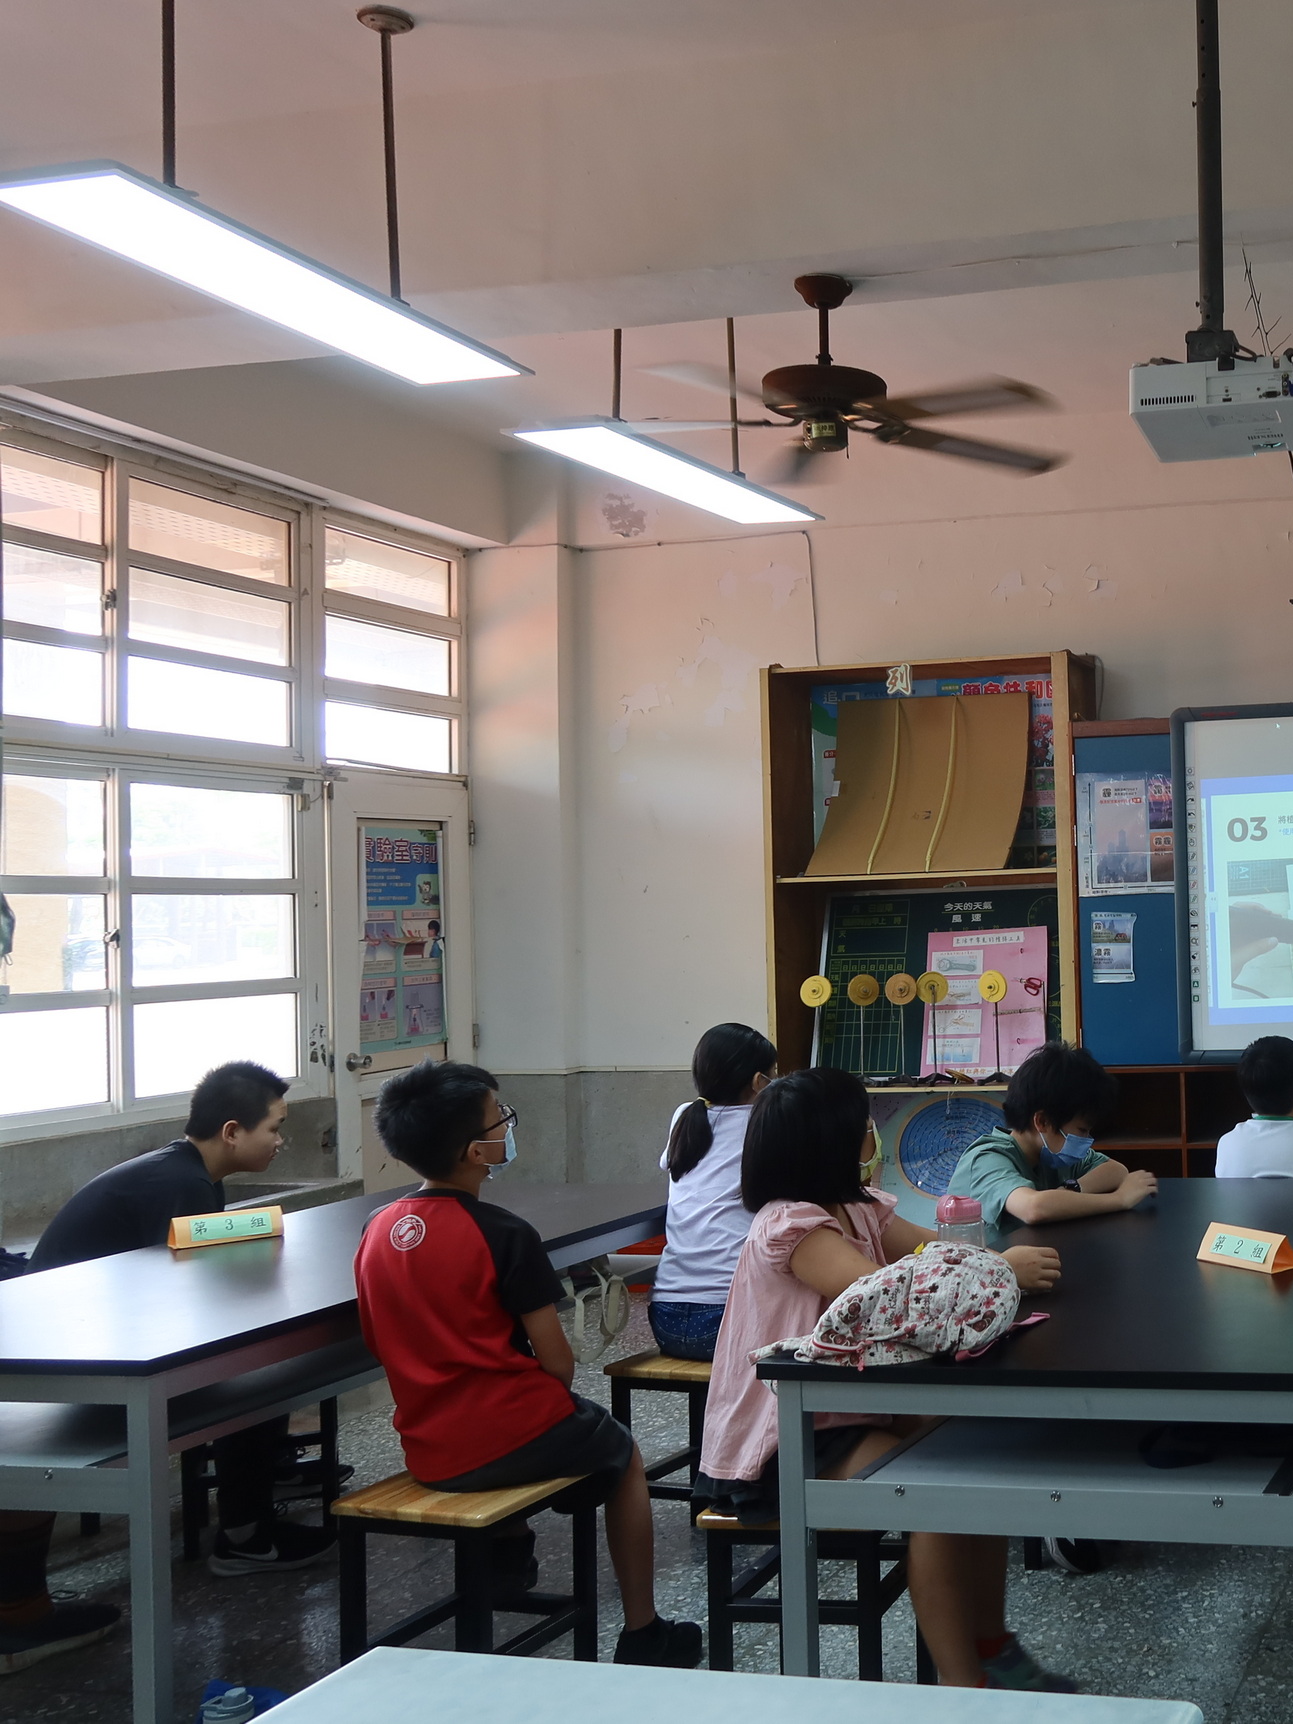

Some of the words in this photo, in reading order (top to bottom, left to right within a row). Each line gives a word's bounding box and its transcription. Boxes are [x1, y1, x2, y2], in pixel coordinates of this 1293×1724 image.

[887, 666, 911, 693] 列
[1226, 816, 1268, 842] 03
[944, 901, 993, 912] 今天的天氣
